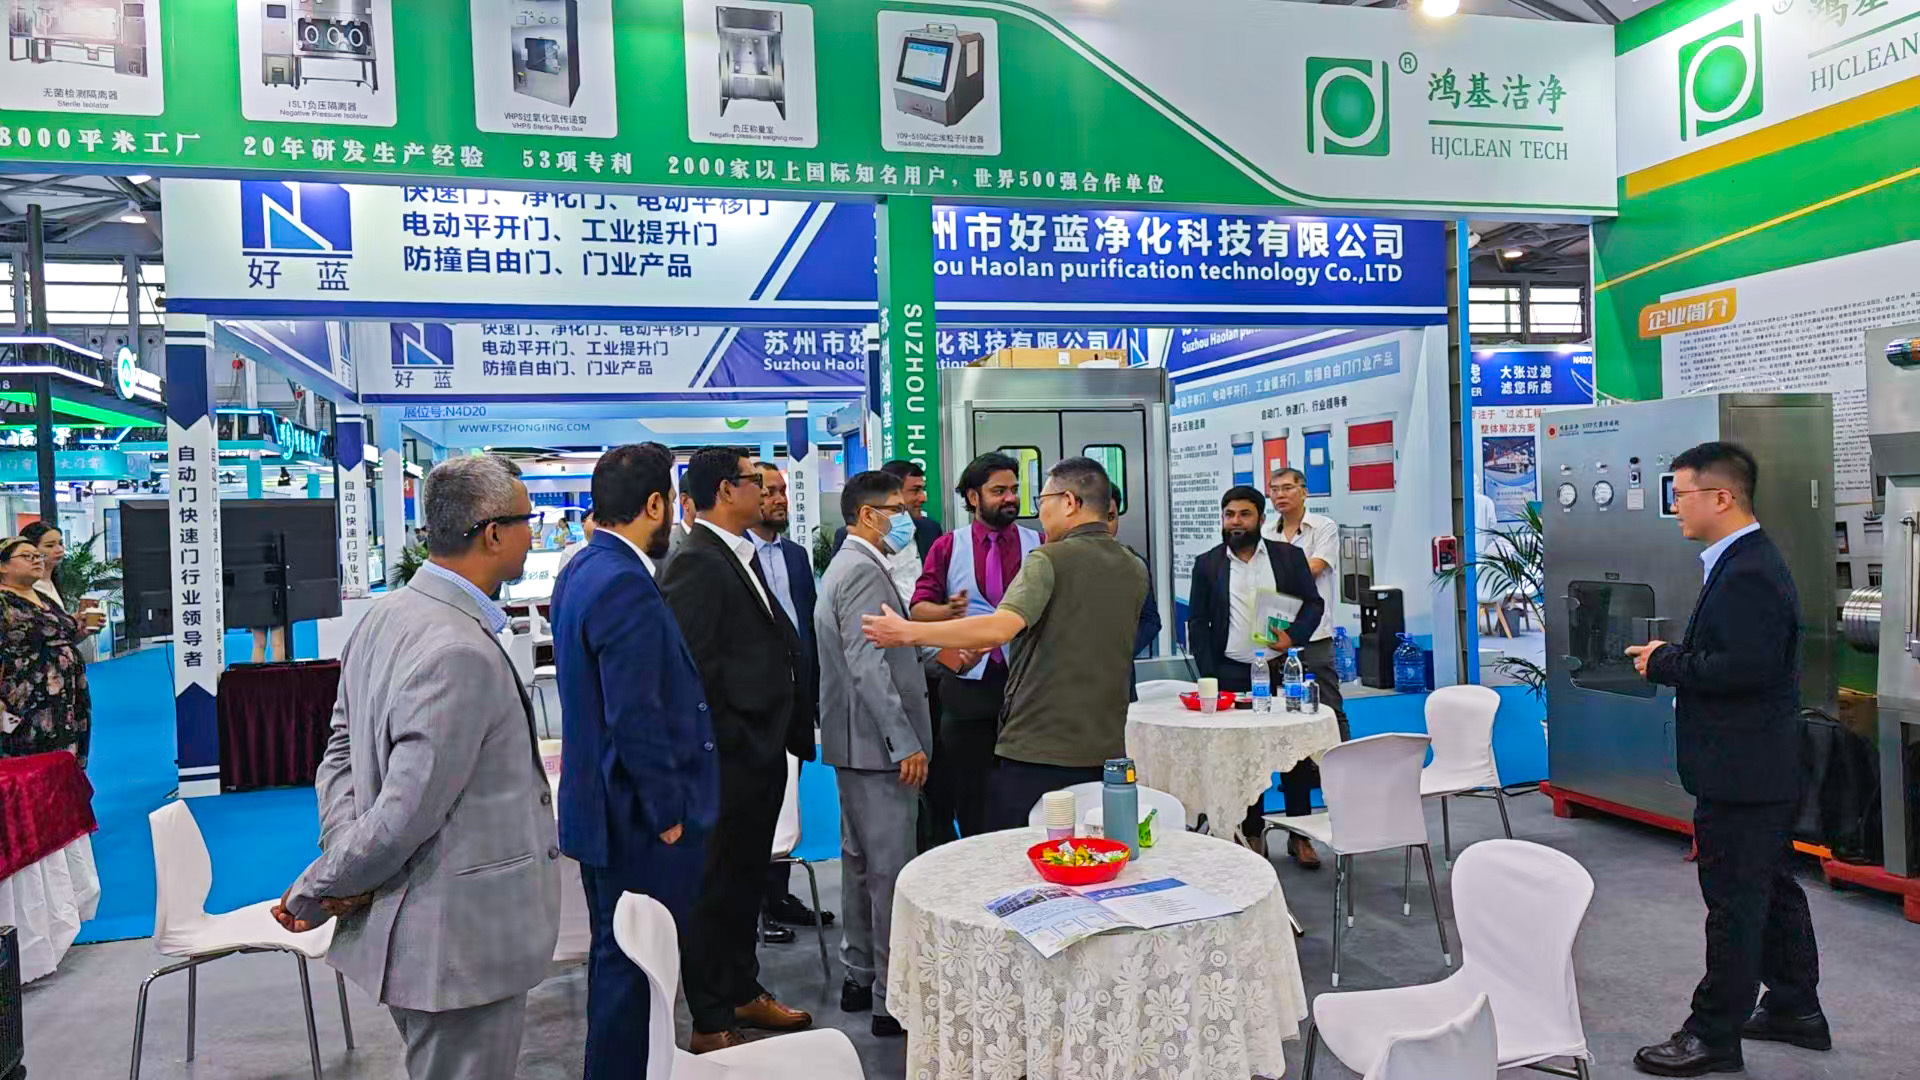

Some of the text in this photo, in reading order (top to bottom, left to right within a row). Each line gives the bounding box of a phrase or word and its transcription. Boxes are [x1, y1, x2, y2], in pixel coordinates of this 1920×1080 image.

[1811, 32, 1919, 92] HJCLEAN
[43, 88, 118, 101] 无菌检测隔离器
[58, 100, 110, 109] Sterile Isolator
[1427, 67, 1567, 115] 鸿基洁净
[243, 136, 485, 168] 20年研发生产经验
[521, 148, 632, 175] 53项专利
[1431, 136, 1569, 160] HJCLEAN TECH
[402, 213, 717, 247] 电动平开门、工业提升门
[932, 210, 1404, 260] 州市好蓝净化科技有限公司
[404, 246, 692, 278] 防撞自由门、门业产品
[971, 256, 1054, 277] Haolan
[1061, 257, 1194, 283] purification
[1200, 258, 1320, 287] technology
[1324, 262, 1404, 284] Co.,LTD
[1647, 296, 1729, 332] 企业简介
[482, 340, 669, 357] 电动平开门、工业提升门
[1181, 337, 1209, 354] Suzhou
[1209, 328, 1239, 346] Haolan
[483, 360, 653, 377] 防撞自由门、门业产品
[764, 358, 821, 371] Suzhou
[903, 303, 925, 412] SUZHOU
[1500, 364, 1553, 380] 大张过滤
[1501, 381, 1553, 396] 滤您所虑
[177, 445, 203, 668] 自动门快速门行业领导者
